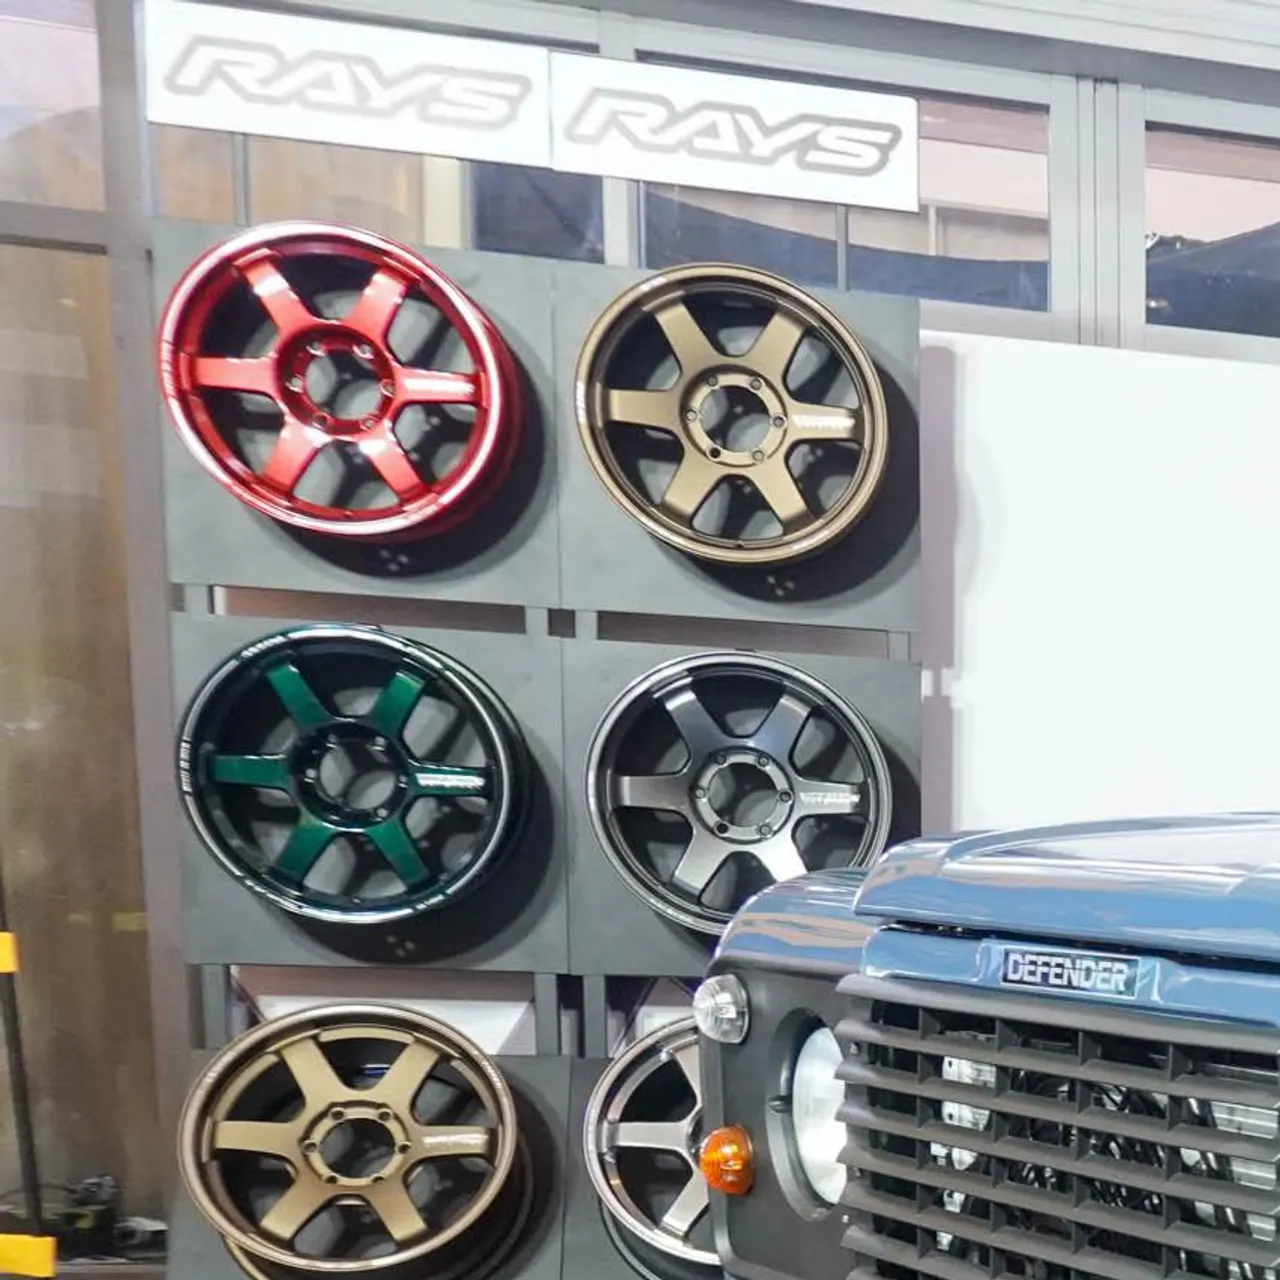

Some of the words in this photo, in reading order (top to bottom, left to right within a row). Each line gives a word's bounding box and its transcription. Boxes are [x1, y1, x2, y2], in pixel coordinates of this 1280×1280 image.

[165, 37, 532, 131] RAYS
[566, 86, 902, 177] RAYS
[1007, 952, 1129, 991] DEFENDER
